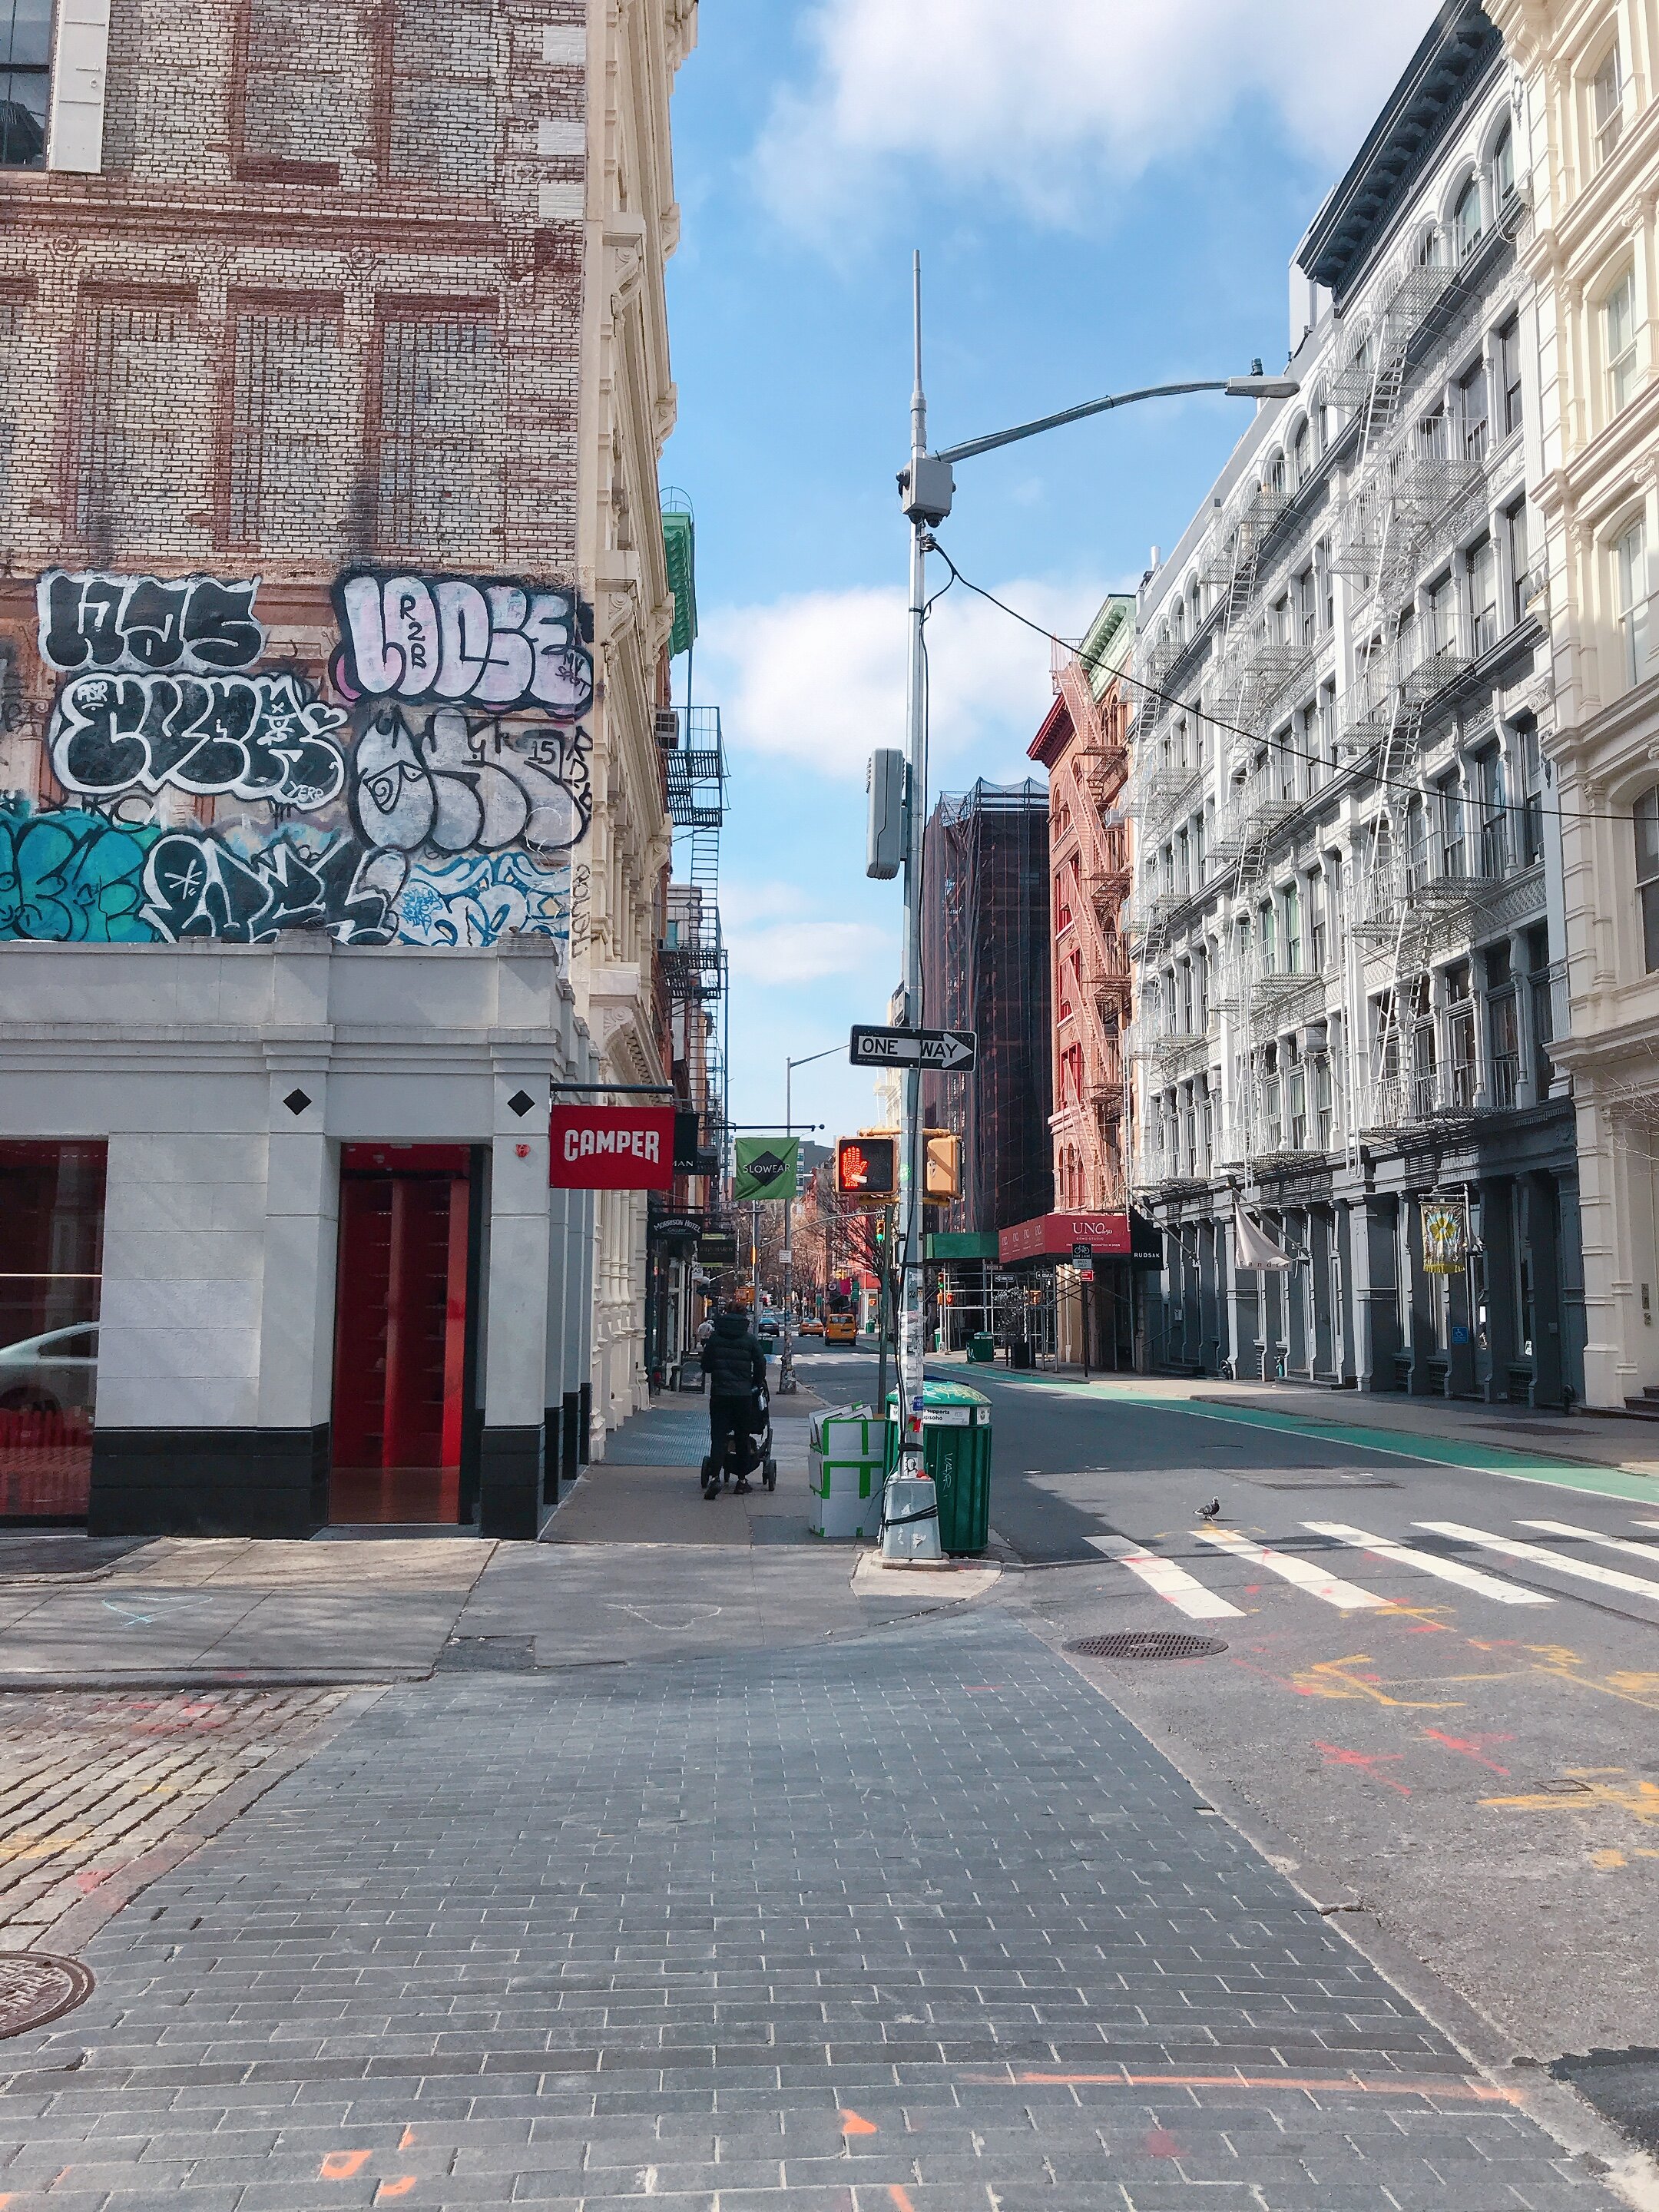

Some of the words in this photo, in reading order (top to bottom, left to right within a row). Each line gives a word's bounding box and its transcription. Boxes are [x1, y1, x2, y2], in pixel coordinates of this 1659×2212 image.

[862, 1038, 898, 1055] ONE
[922, 1041, 959, 1058] WAY
[564, 1129, 660, 1164] CAMPER
[743, 1163, 790, 1174] SLOWEAR
[654, 1219, 684, 1231] MORRISON
[684, 1219, 701, 1233] HOTEL
